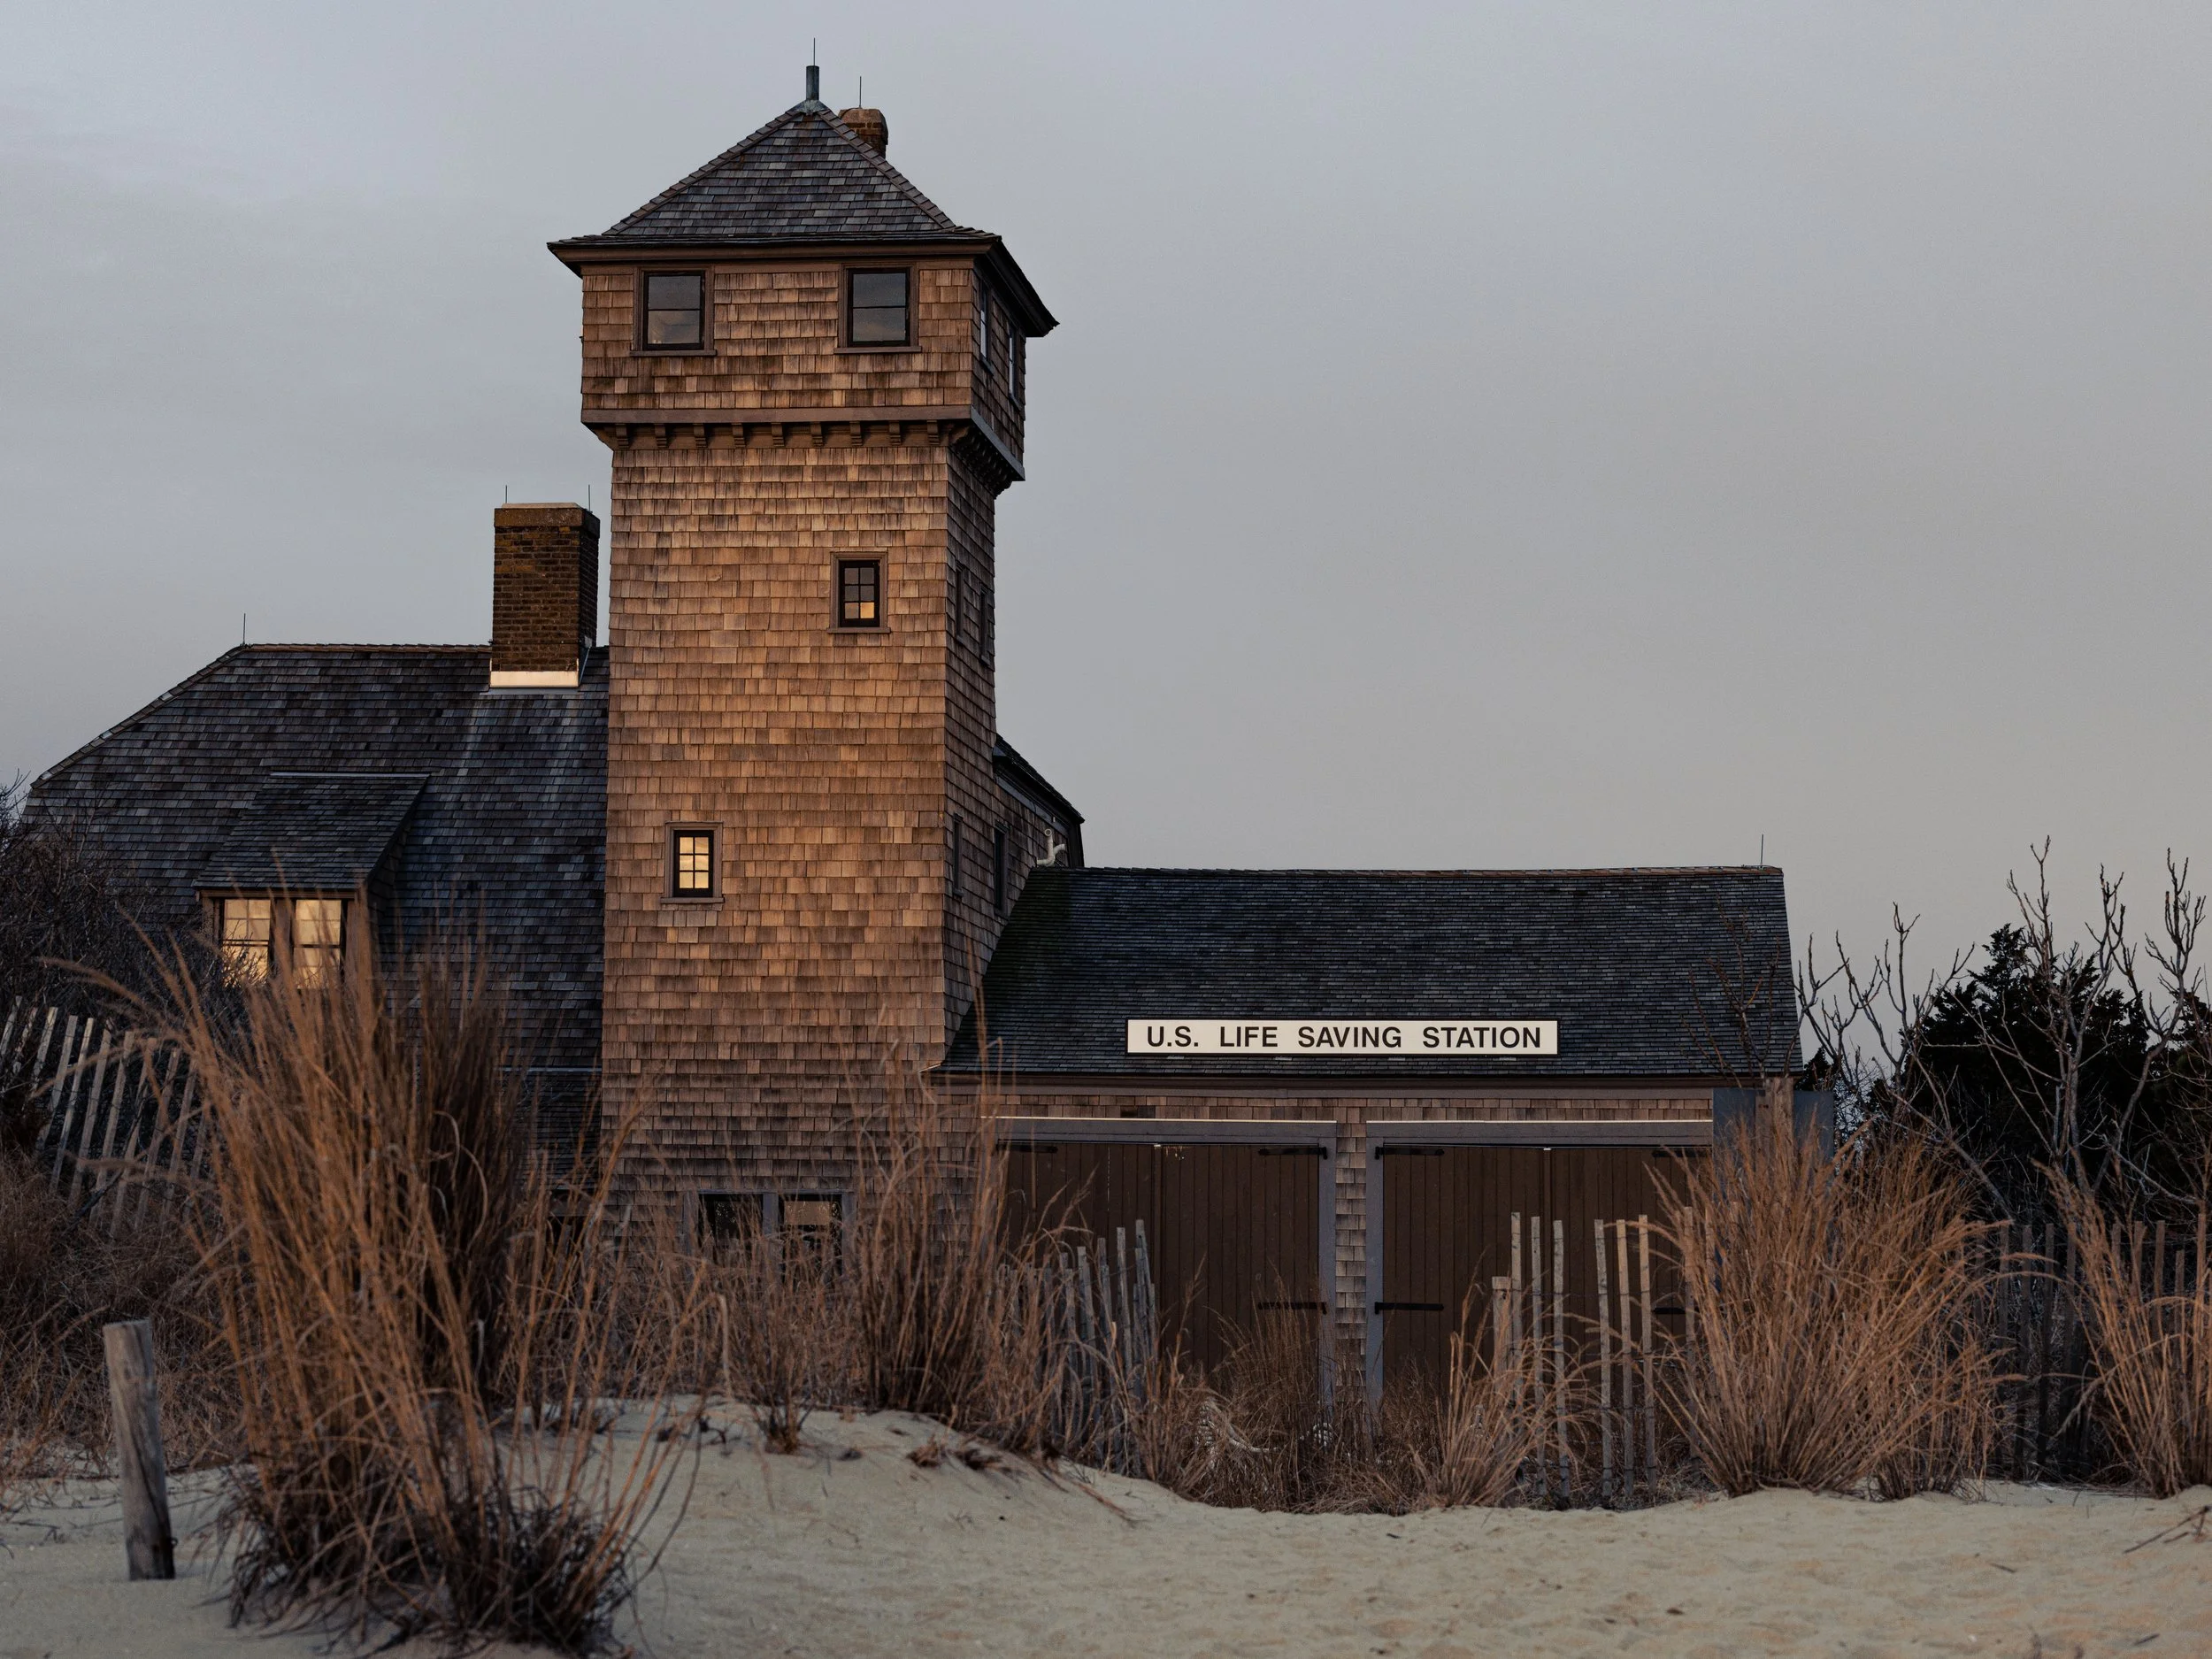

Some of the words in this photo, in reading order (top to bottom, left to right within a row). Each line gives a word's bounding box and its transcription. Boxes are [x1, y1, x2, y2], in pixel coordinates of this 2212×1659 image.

[1147, 1025, 1199, 1048] U.S.
[1220, 1025, 1279, 1048] LIFE
[1298, 1026, 1402, 1048] SAVING
[1422, 1026, 1540, 1048] STATION
